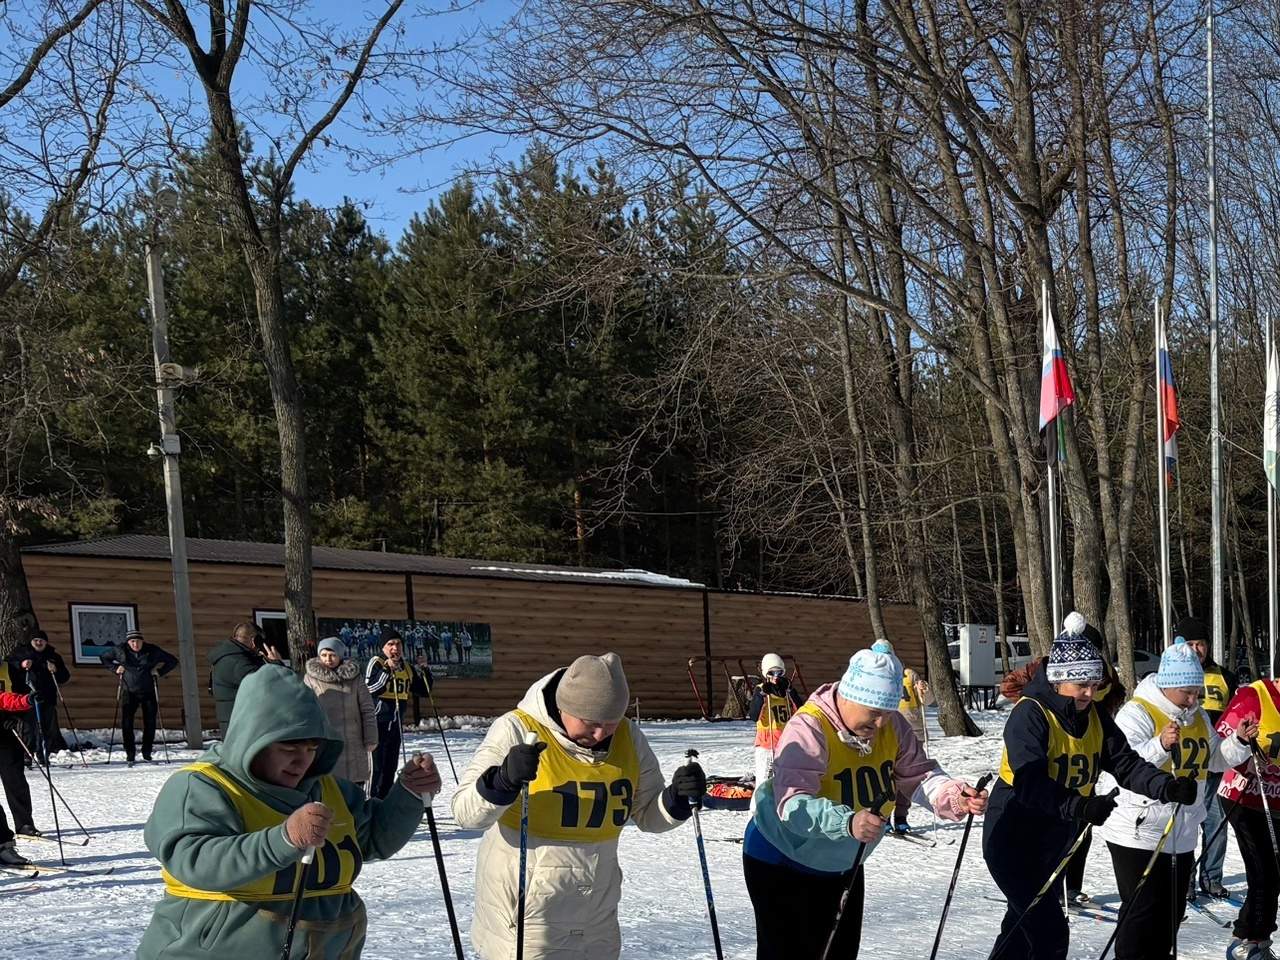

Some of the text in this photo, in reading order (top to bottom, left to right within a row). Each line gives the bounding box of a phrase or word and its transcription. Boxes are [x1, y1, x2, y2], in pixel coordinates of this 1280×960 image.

[771, 705, 791, 723] 15
[552, 778, 633, 828] 173
[834, 759, 896, 809] 106
